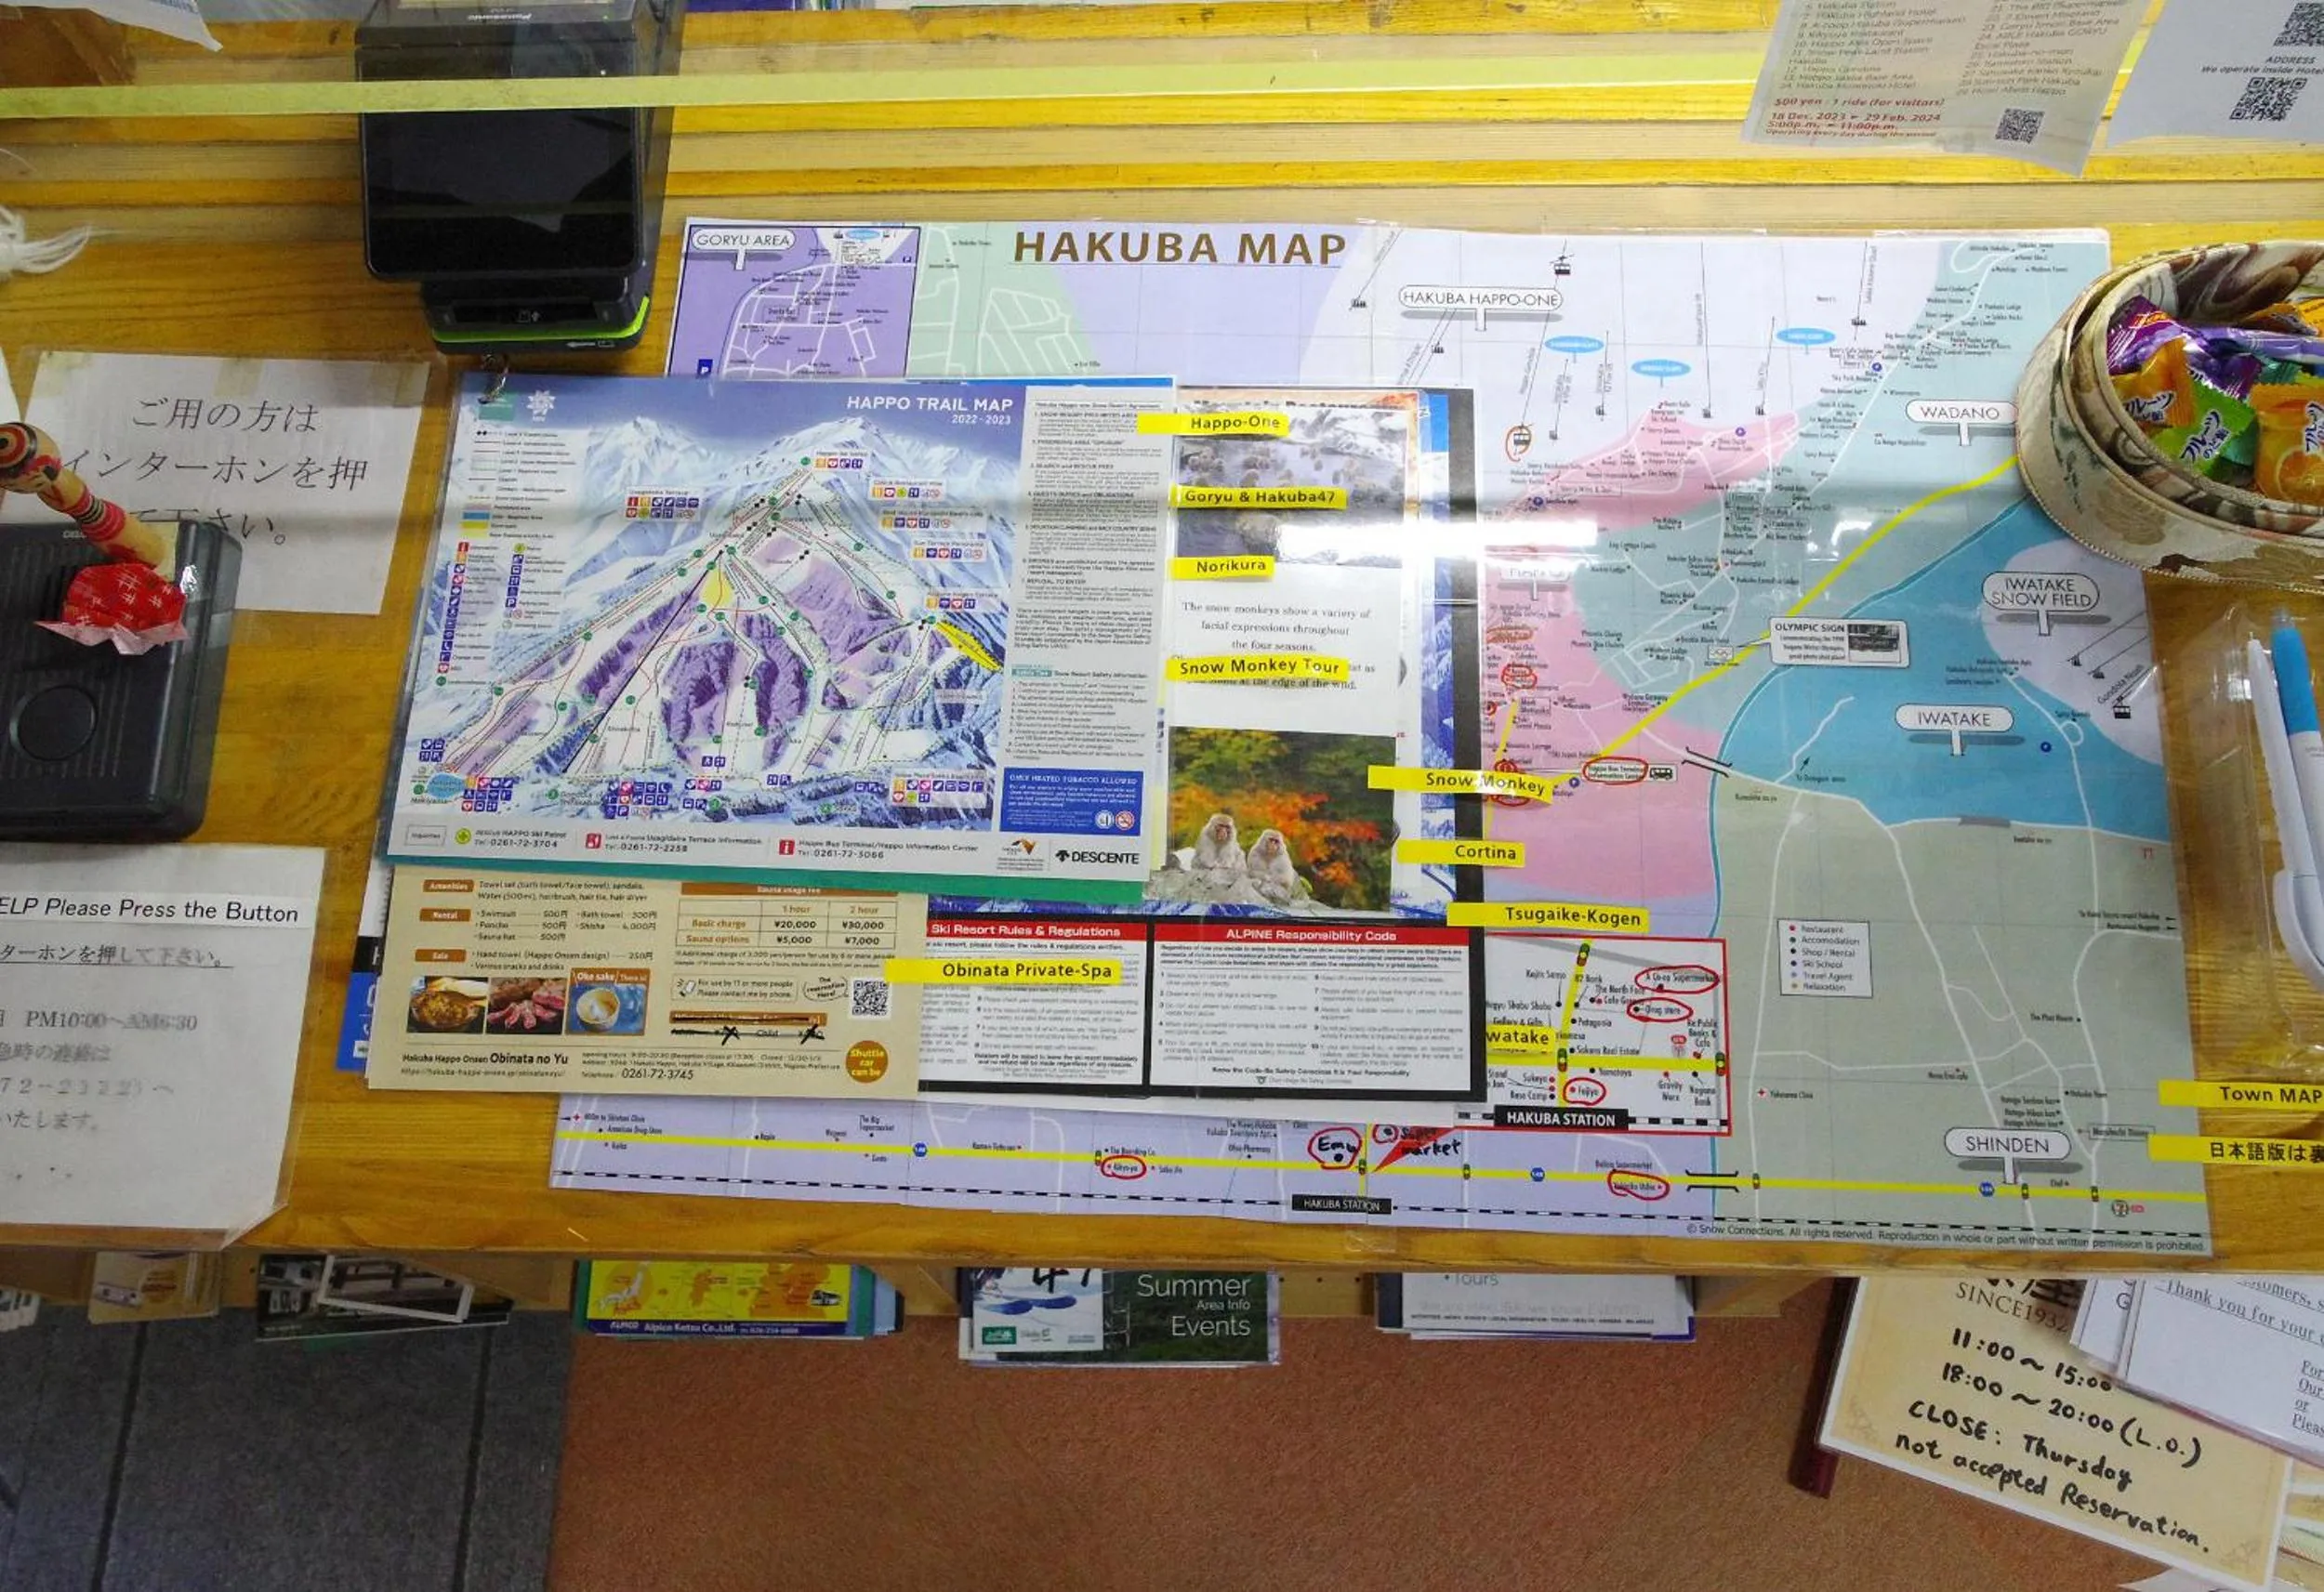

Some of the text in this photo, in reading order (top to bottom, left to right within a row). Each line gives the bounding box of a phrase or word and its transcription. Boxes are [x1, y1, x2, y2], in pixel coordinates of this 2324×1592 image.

[696, 233, 791, 247] GORYU AREA
[1013, 231, 1347, 266] HAKUBA MAP
[1403, 292, 1559, 307] HAKUBA HAPPO-ONE
[847, 396, 1013, 412] HAPPO TRAIL MAP
[131, 397, 321, 434] ご用の方は
[1920, 405, 2000, 420] WADANO
[1191, 415, 1281, 432] Happo-One
[62, 449, 370, 491] インターホンを押
[1185, 490, 1336, 505] Goryu & Hakuba47
[1196, 559, 1266, 573] Norikura
[2005, 578, 2077, 592] IWATAKE
[1991, 590, 2091, 607] SNOW FIELD
[1182, 601, 1203, 612] The
[1205, 603, 1231, 613] snow
[1235, 604, 1280, 616] monkeys
[1282, 605, 1309, 615] show
[1360, 609, 1371, 618] of
[1201, 620, 1350, 637] facial expressions throughout
[1775, 624, 1844, 632] OLYMPIC SIGN
[1232, 640, 1316, 651] the four seasons.
[1180, 657, 1340, 676] Snow Monkey Tour
[1917, 712, 1992, 728] IWATAKE
[1426, 772, 1546, 796] Snow Monkey
[489, 838, 559, 849] 0261-72-3704
[1071, 850, 1141, 865] DESCENTE
[1455, 845, 1517, 860] Cortina
[44, 897, 112, 918] Please
[118, 899, 176, 919] Press
[183, 901, 218, 919] the
[226, 901, 299, 923] Button
[850, 905, 855, 914] 2
[1505, 906, 1642, 927] Tsugaike-Kogen
[692, 919, 746, 930] Basic charge
[773, 920, 817, 930] ¥20,000
[842, 920, 885, 931] ¥30,000
[931, 925, 1121, 937] Ski Resort Rules & Regulations
[686, 935, 750, 945] Sauna options
[776, 936, 812, 945] ¥5,000
[844, 937, 879, 946] ¥7,000
[1226, 929, 1397, 942] ALPINE Responsibility Code
[943, 963, 1113, 980] Obinata Private-Spa
[1829, 973, 1853, 982] Agent
[1803, 983, 1846, 992] Relaxation
[1578, 1019, 1612, 1028] Patagonia
[1487, 1029, 1549, 1045] watake
[489, 1052, 535, 1065] Obinata
[536, 1055, 551, 1064] no
[554, 1054, 569, 1065] Yu
[850, 1048, 885, 1058] Shuttle
[621, 1068, 693, 1080] 0261-72-3745
[2219, 1086, 2322, 1104] Town MAP
[1507, 1112, 1616, 1127] HAKUBA STATION
[1318, 1136, 1356, 1152] Emu
[1965, 1136, 2051, 1153] SHINDEN
[2210, 1141, 2324, 1164] 日本語版は裏
[1303, 1198, 1380, 1212] HAKUBA STATION
[1699, 1225, 1725, 1234] Snow
[1727, 1225, 1785, 1236] Connections.
[1789, 1227, 1802, 1236] All
[1803, 1228, 1830, 1239] rights
[1879, 1230, 1939, 1243] Reproduction
[1953, 1235, 1981, 1243] whole
[1997, 1236, 2016, 1246] part
[2018, 1236, 2054, 1246] without
[2056, 1237, 2090, 1247] written
[2093, 1240, 2144, 1251] permission
[2145, 1241, 2153, 1250] is
[1136, 1273, 1251, 1299] Summer
[1196, 1300, 1251, 1311] Area Info
[2166, 1279, 2317, 1343] Thank you for your
[643, 1322, 673, 1335] Alpico
[1170, 1316, 1251, 1337] Events
[1951, 1328, 2015, 1364] 11:00
[2055, 1361, 2113, 1393] 15:00
[1942, 1362, 2004, 1400] 18:00
[2048, 1398, 2114, 1435] 20:00
[2295, 1399, 2309, 1411] or
[1908, 1400, 2133, 1491] CLOSE: Thursday
[1895, 1431, 2211, 1556] not accepted Reservation.
